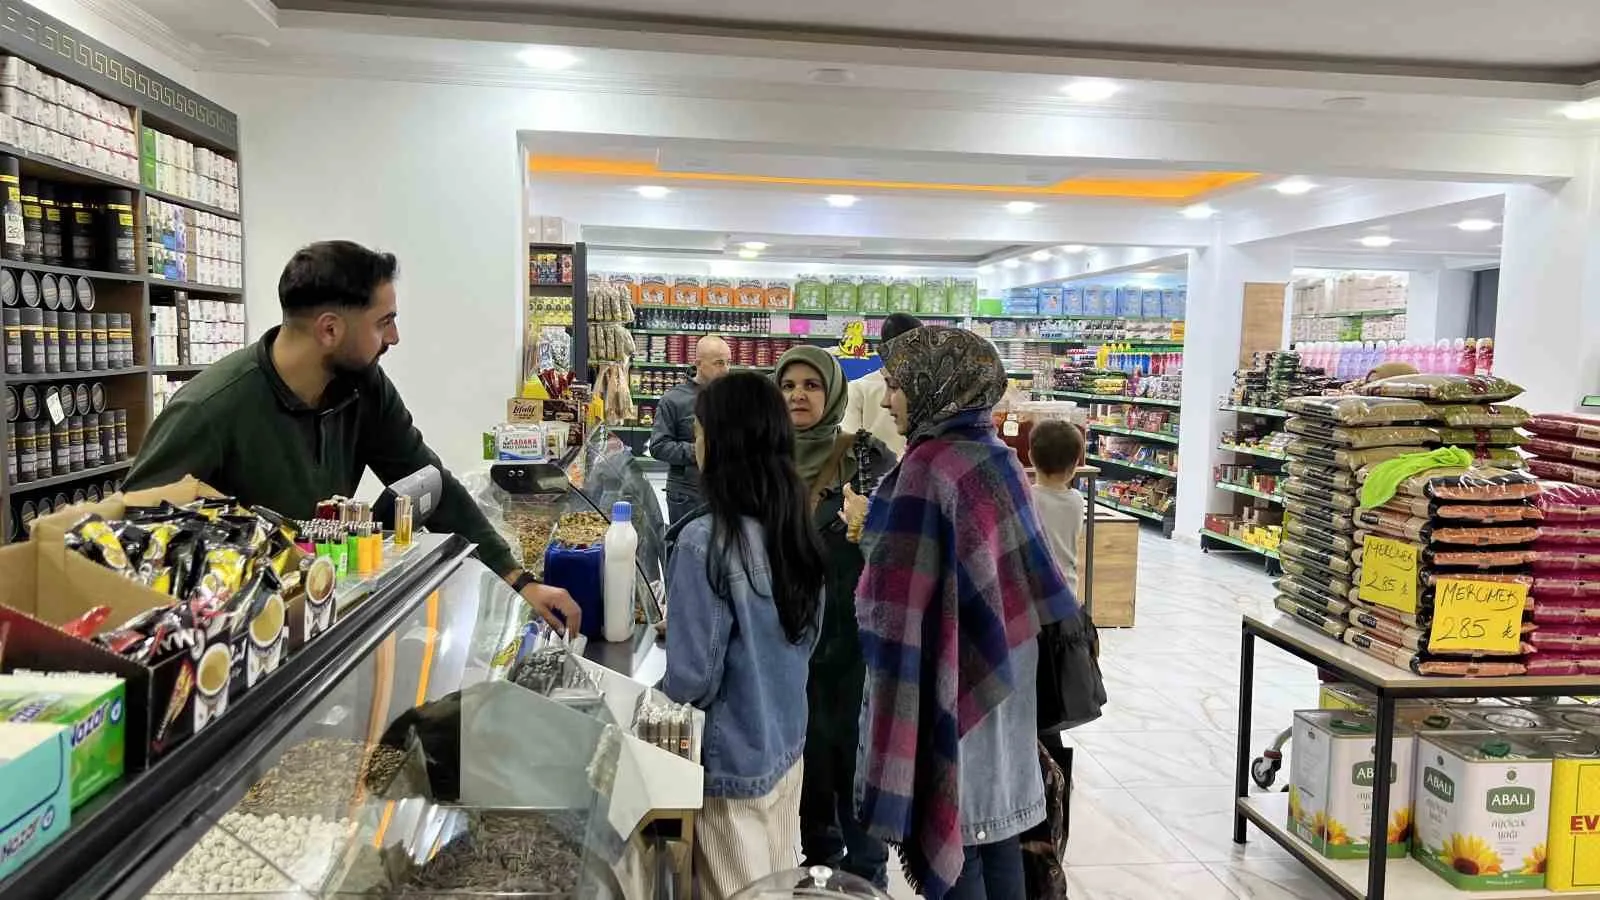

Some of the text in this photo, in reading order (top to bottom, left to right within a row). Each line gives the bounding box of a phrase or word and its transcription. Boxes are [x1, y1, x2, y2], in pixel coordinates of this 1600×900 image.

[1436, 617, 1490, 641] 285
[1426, 773, 1452, 796] ABALI
[1491, 793, 1530, 806] ABALI
